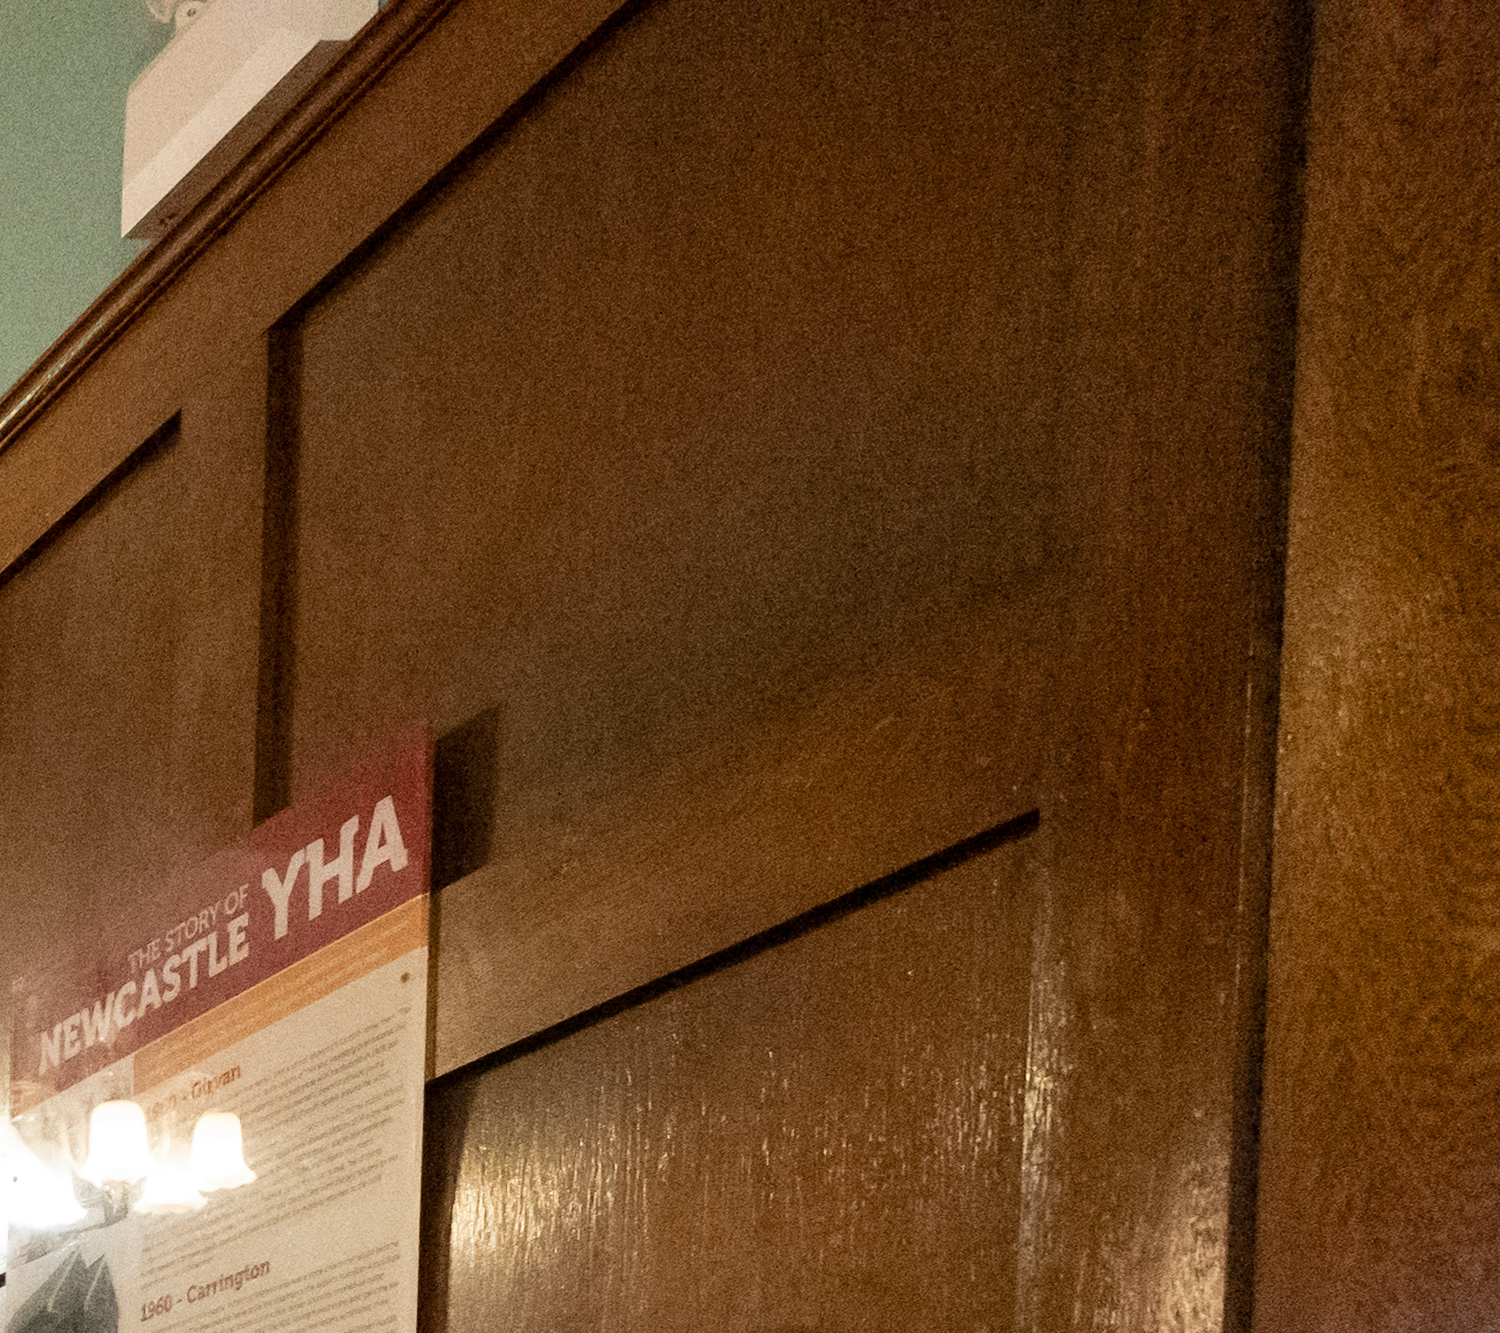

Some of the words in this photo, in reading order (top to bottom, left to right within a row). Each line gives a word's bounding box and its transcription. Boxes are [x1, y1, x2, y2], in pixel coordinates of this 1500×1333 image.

[38, 911, 251, 1078] NEWCASTLE
[261, 794, 410, 941] YHA
[127, 938, 161, 974] THE
[165, 905, 220, 953] STORY
[218, 883, 250, 917] OF
[139, 1294, 173, 1323] 1960
[186, 1260, 271, 1304] Carrington
